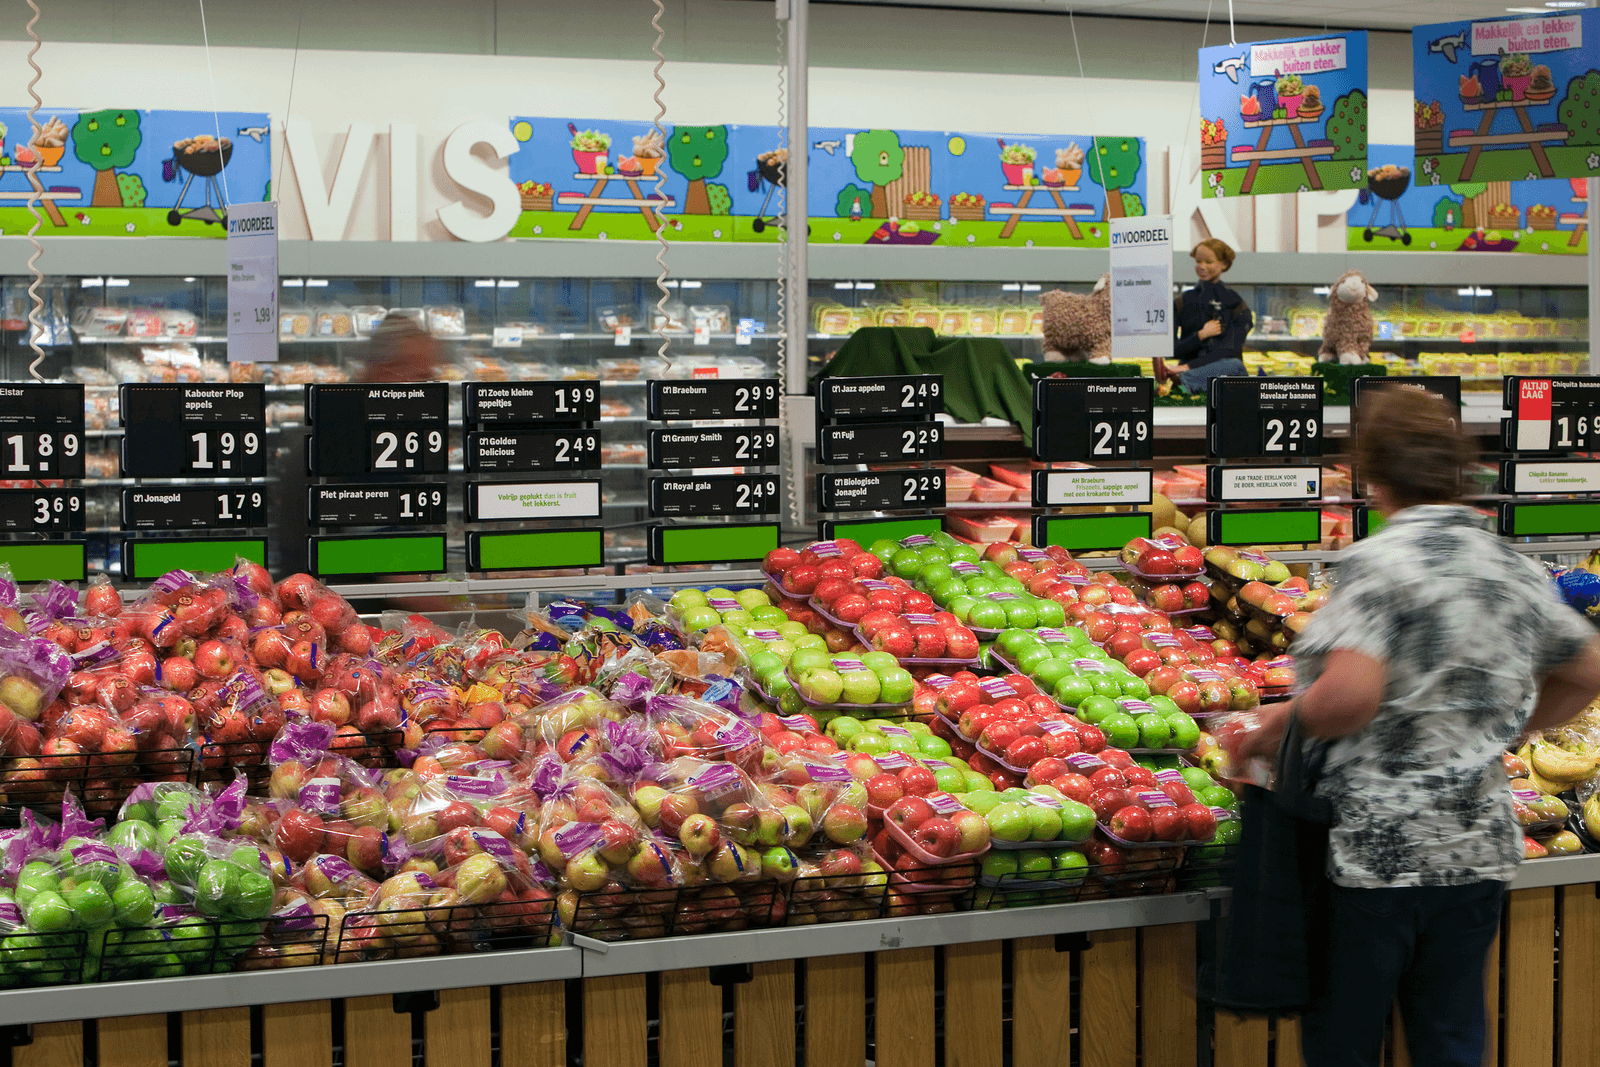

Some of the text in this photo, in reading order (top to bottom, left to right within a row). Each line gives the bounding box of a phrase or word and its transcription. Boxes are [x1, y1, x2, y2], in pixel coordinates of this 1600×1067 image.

[1475, 19, 1577, 41] Makkelijk en lekker
[1299, 48, 1310, 58] en
[1312, 42, 1341, 56] lekker
[1507, 35, 1571, 52] buiten eten.
[1283, 58, 1336, 73] buiten eten.
[281, 118, 522, 243] VIS
[237, 216, 274, 232] VOORDEEL
[1122, 228, 1169, 244] VOORDEEL
[254, 307, 271, 325] 1,99
[1146, 309, 1165, 325] 1,79
[0, 388, 24, 396] Elstar
[488, 389, 510, 397] Zoete
[511, 388, 533, 397] kleine
[672, 386, 707, 394] Braeburn
[841, 385, 857, 393] Jazz
[858, 384, 886, 393] appelen
[1095, 385, 1117, 393] Forelle
[1118, 386, 1137, 394] peren
[1268, 383, 1299, 391] Biologisch
[1522, 381, 1549, 390] ALTIJD
[1552, 381, 1578, 389] Chiquita
[185, 389, 244, 400] Kabouter Plop
[368, 389, 425, 399] AH Cripps pink
[554, 388, 595, 413] 1.99
[735, 386, 774, 411] 2.99
[901, 383, 940, 408] 2.49
[1260, 392, 1289, 400] Havelaar
[1521, 390, 1544, 399] LAAG
[185, 400, 213, 409] appels
[478, 399, 512, 409] appeltjes
[490, 437, 517, 445] Golden
[671, 435, 699, 444] Granny
[700, 433, 723, 442] Smith
[841, 430, 855, 440] Fuji
[902, 428, 939, 454] 2.29
[1093, 421, 1148, 455] 2.49
[1265, 418, 1318, 451] 2.29
[7, 433, 79, 471] 1.89
[191, 432, 259, 469] 1.99
[375, 431, 442, 468] 2.69
[479, 448, 515, 456] Delicious
[555, 436, 596, 462] 2.49
[735, 433, 775, 459] 2.29
[673, 482, 693, 491] Royal
[695, 482, 711, 491] gala
[843, 477, 880, 486] Biologisch
[903, 476, 941, 501] 2.29
[144, 494, 181, 504] Jonagold
[320, 490, 389, 500] Piet piraat peren
[498, 493, 518, 501] Volrijp
[519, 493, 543, 501] geplukt
[736, 481, 776, 508] 2.49
[834, 488, 867, 497] Jonagold
[34, 496, 80, 524] 3.69
[218, 492, 262, 520] 1.79
[400, 491, 441, 518] 1.69
